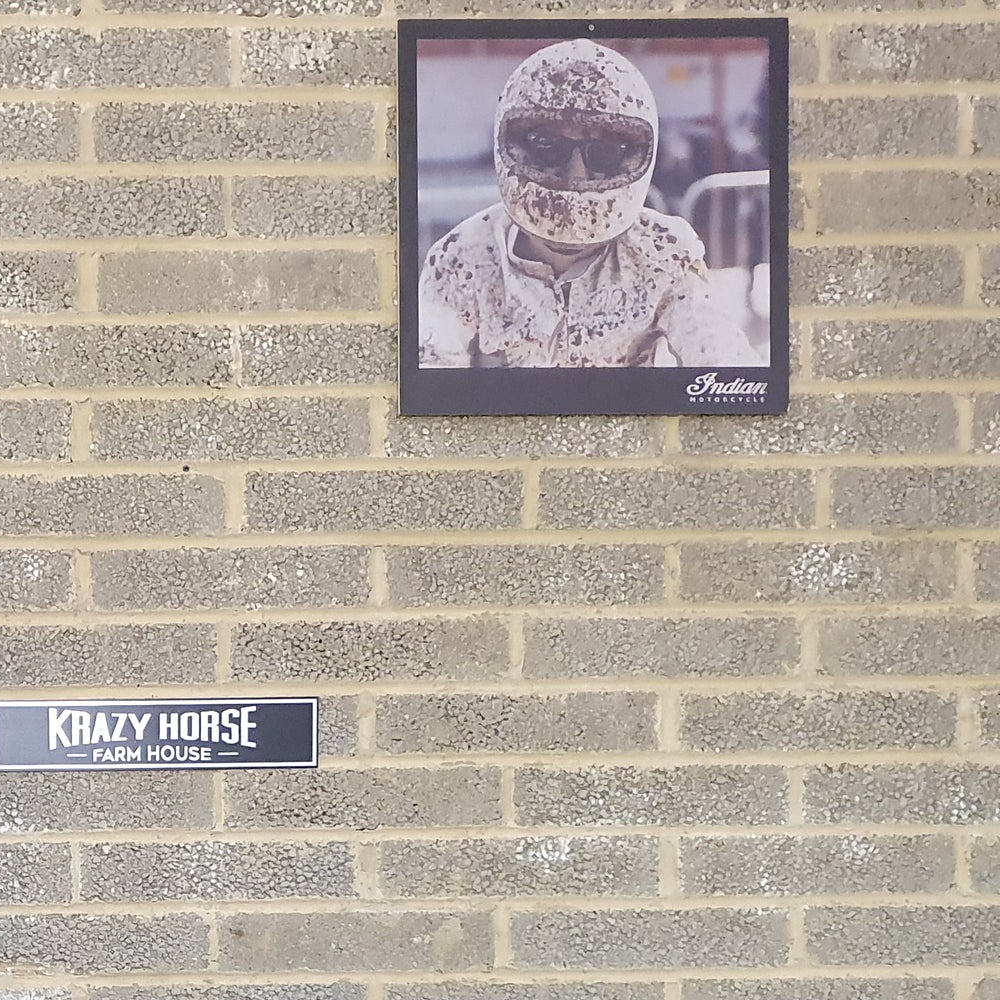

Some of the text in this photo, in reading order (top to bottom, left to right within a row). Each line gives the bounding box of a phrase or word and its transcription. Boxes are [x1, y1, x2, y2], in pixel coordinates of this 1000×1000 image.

[686, 372, 768, 396] Indian
[48, 705, 257, 751] KRAZY HORSE
[92, 745, 212, 762] FARM HOUSE
